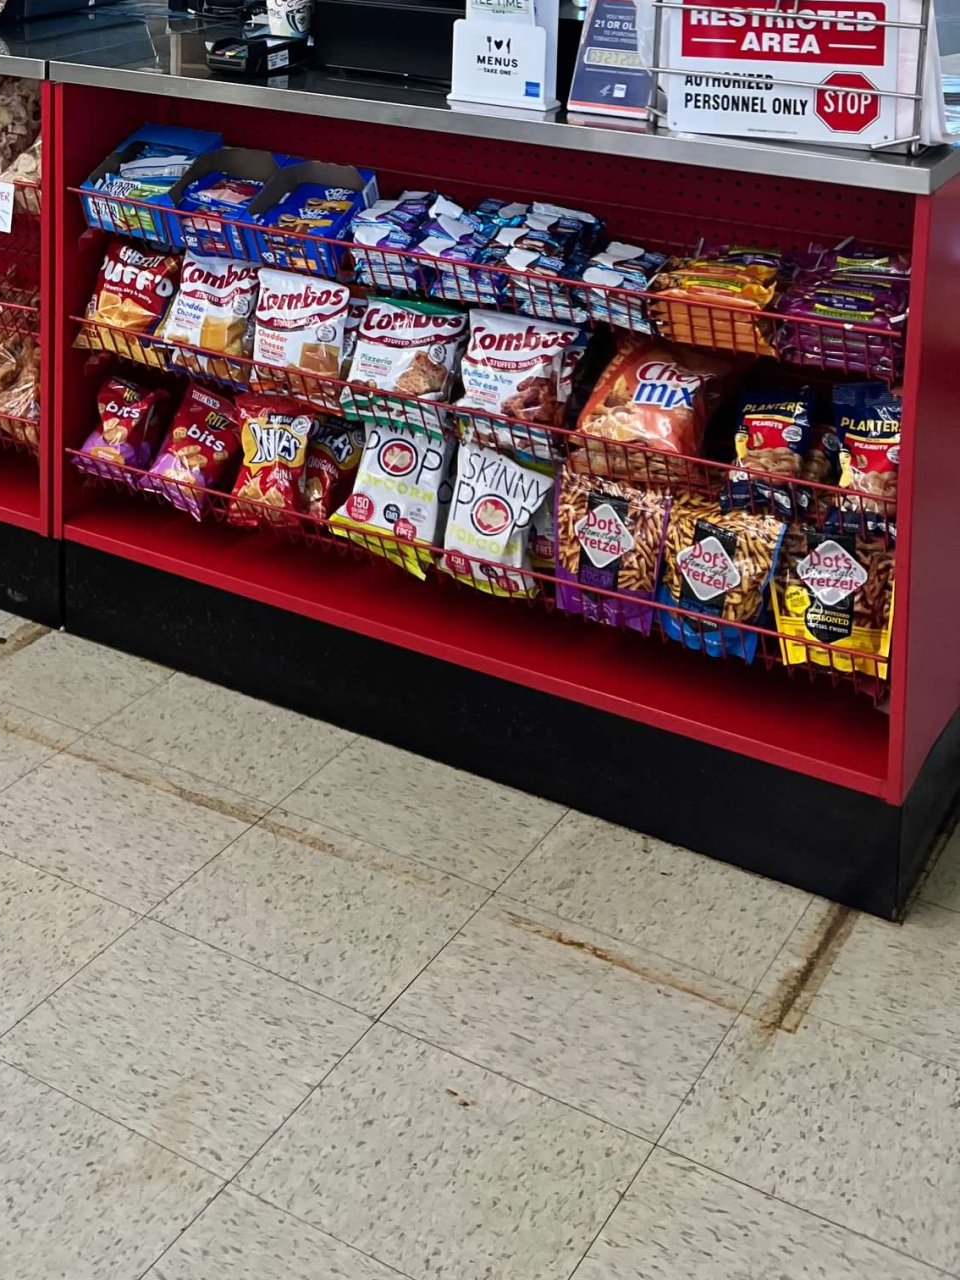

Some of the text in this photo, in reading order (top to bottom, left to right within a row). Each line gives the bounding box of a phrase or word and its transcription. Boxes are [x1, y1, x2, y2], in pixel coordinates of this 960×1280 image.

[594, 19, 620, 29] 21 OR
[691, 7, 877, 32] RESTRICTED
[740, 31, 821, 55] AREA
[477, 55, 519, 68] MENUS
[483, 67, 498, 75] TAKE
[685, 71, 774, 91] AUTHORIZED
[684, 93, 808, 116] PERSONNEL ONLY
[823, 90, 872, 114] STOP
[181, 261, 261, 290] Combos
[257, 282, 346, 312] Combos
[363, 307, 463, 331] Combos
[258, 328, 288, 344] Cheddar
[259, 337, 285, 352] Cheese
[470, 326, 574, 352] Combos
[360, 352, 393, 366] Pizzeria
[489, 357, 543, 370] STUFFED SNACKS
[637, 362, 711, 385] Chex
[633, 382, 696, 409] mix
[106, 400, 140, 419] bits
[742, 401, 805, 413] PLANTERS
[205, 411, 230, 431] RITZ
[751, 420, 783, 430] PEANUTS
[186, 423, 226, 453] bits
[854, 441, 888, 451] PEANUTS
[462, 453, 549, 507] SKINNY
[353, 497, 370, 510] 150
[395, 526, 414, 541] FREE
[585, 511, 622, 535] Dot's
[575, 530, 628, 556] Pretzels
[690, 541, 729, 570] Dot's
[809, 549, 853, 570] Dot's
[679, 559, 733, 591] Pretzels
